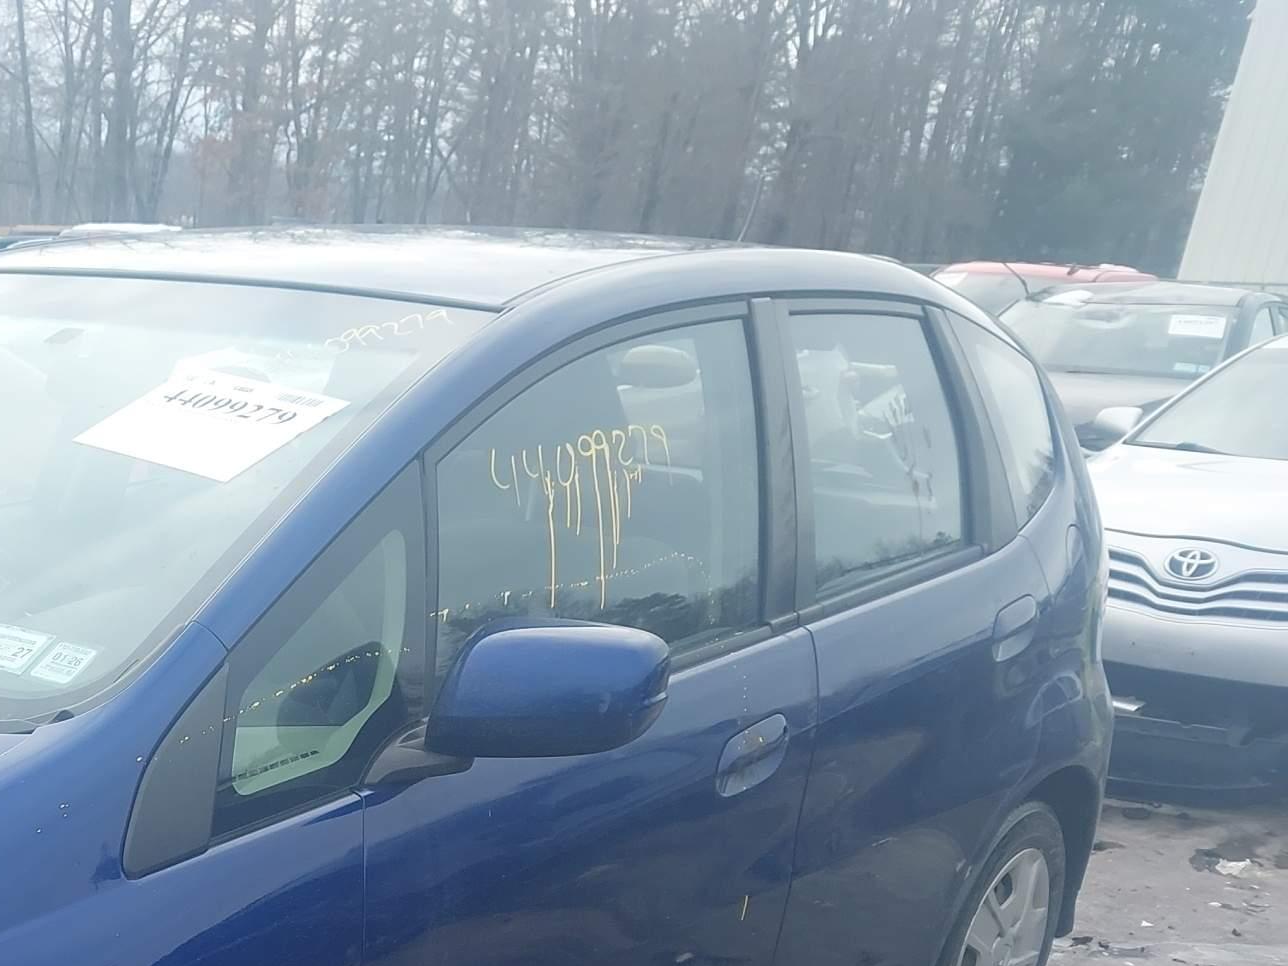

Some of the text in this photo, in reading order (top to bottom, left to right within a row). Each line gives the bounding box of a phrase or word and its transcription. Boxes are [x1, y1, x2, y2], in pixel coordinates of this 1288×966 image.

[163, 388, 298, 425] 44099279
[488, 423, 674, 508] 44099279
[11, 646, 33, 659] 27
